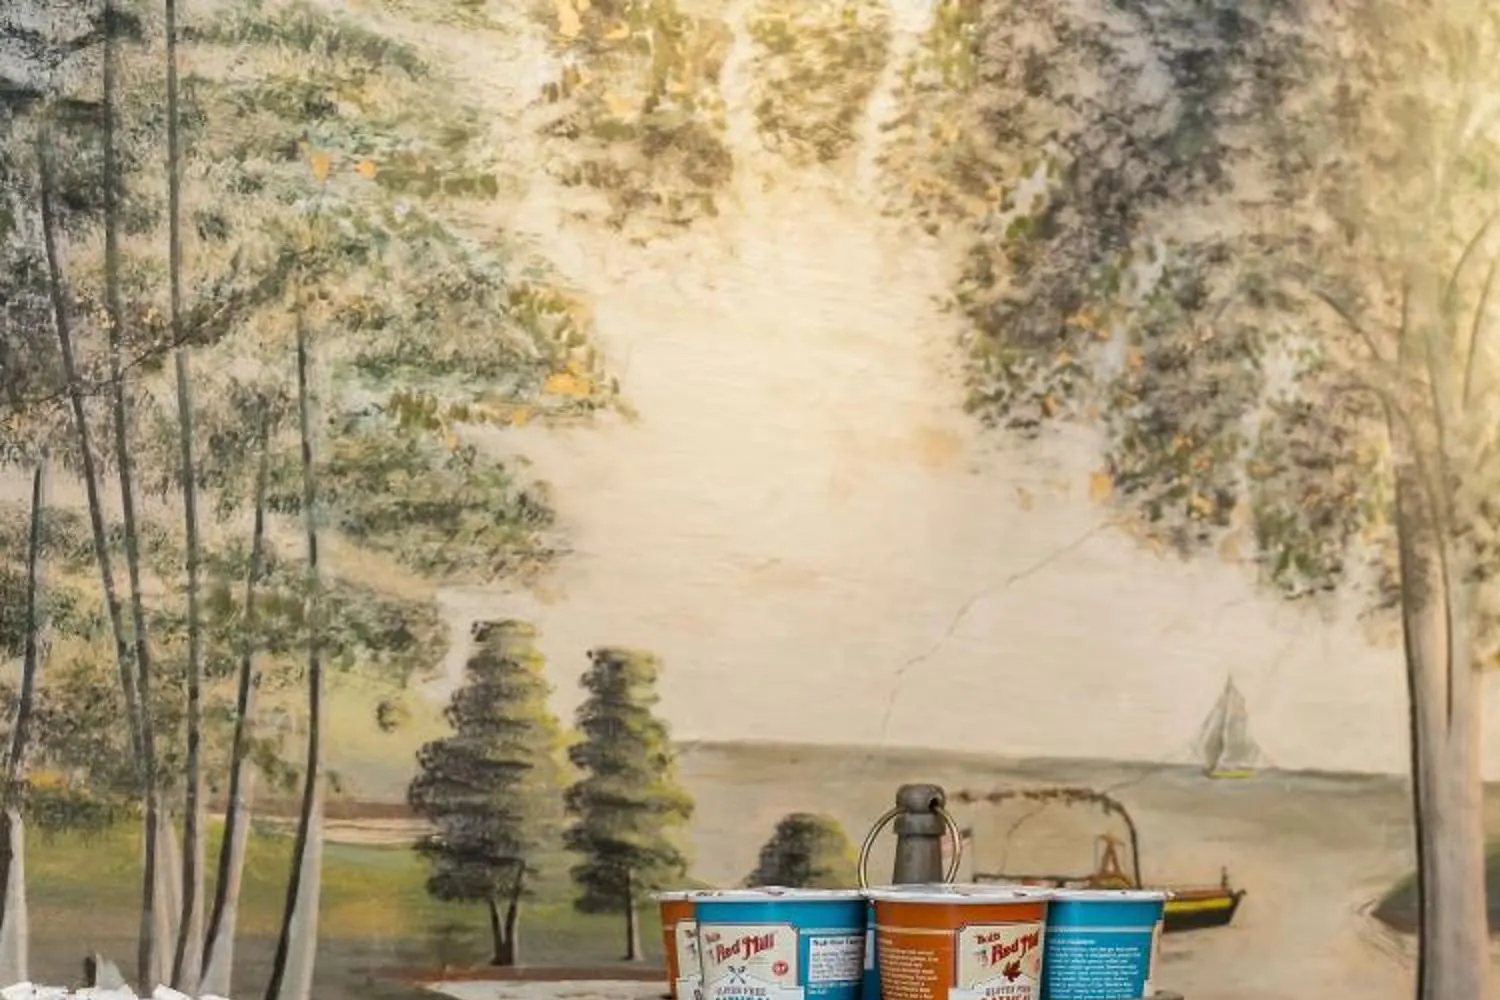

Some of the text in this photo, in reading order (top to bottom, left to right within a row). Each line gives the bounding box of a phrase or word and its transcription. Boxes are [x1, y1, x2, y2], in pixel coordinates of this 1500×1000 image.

[715, 932, 775, 965] Red Mill
[991, 938, 1019, 966] Red
